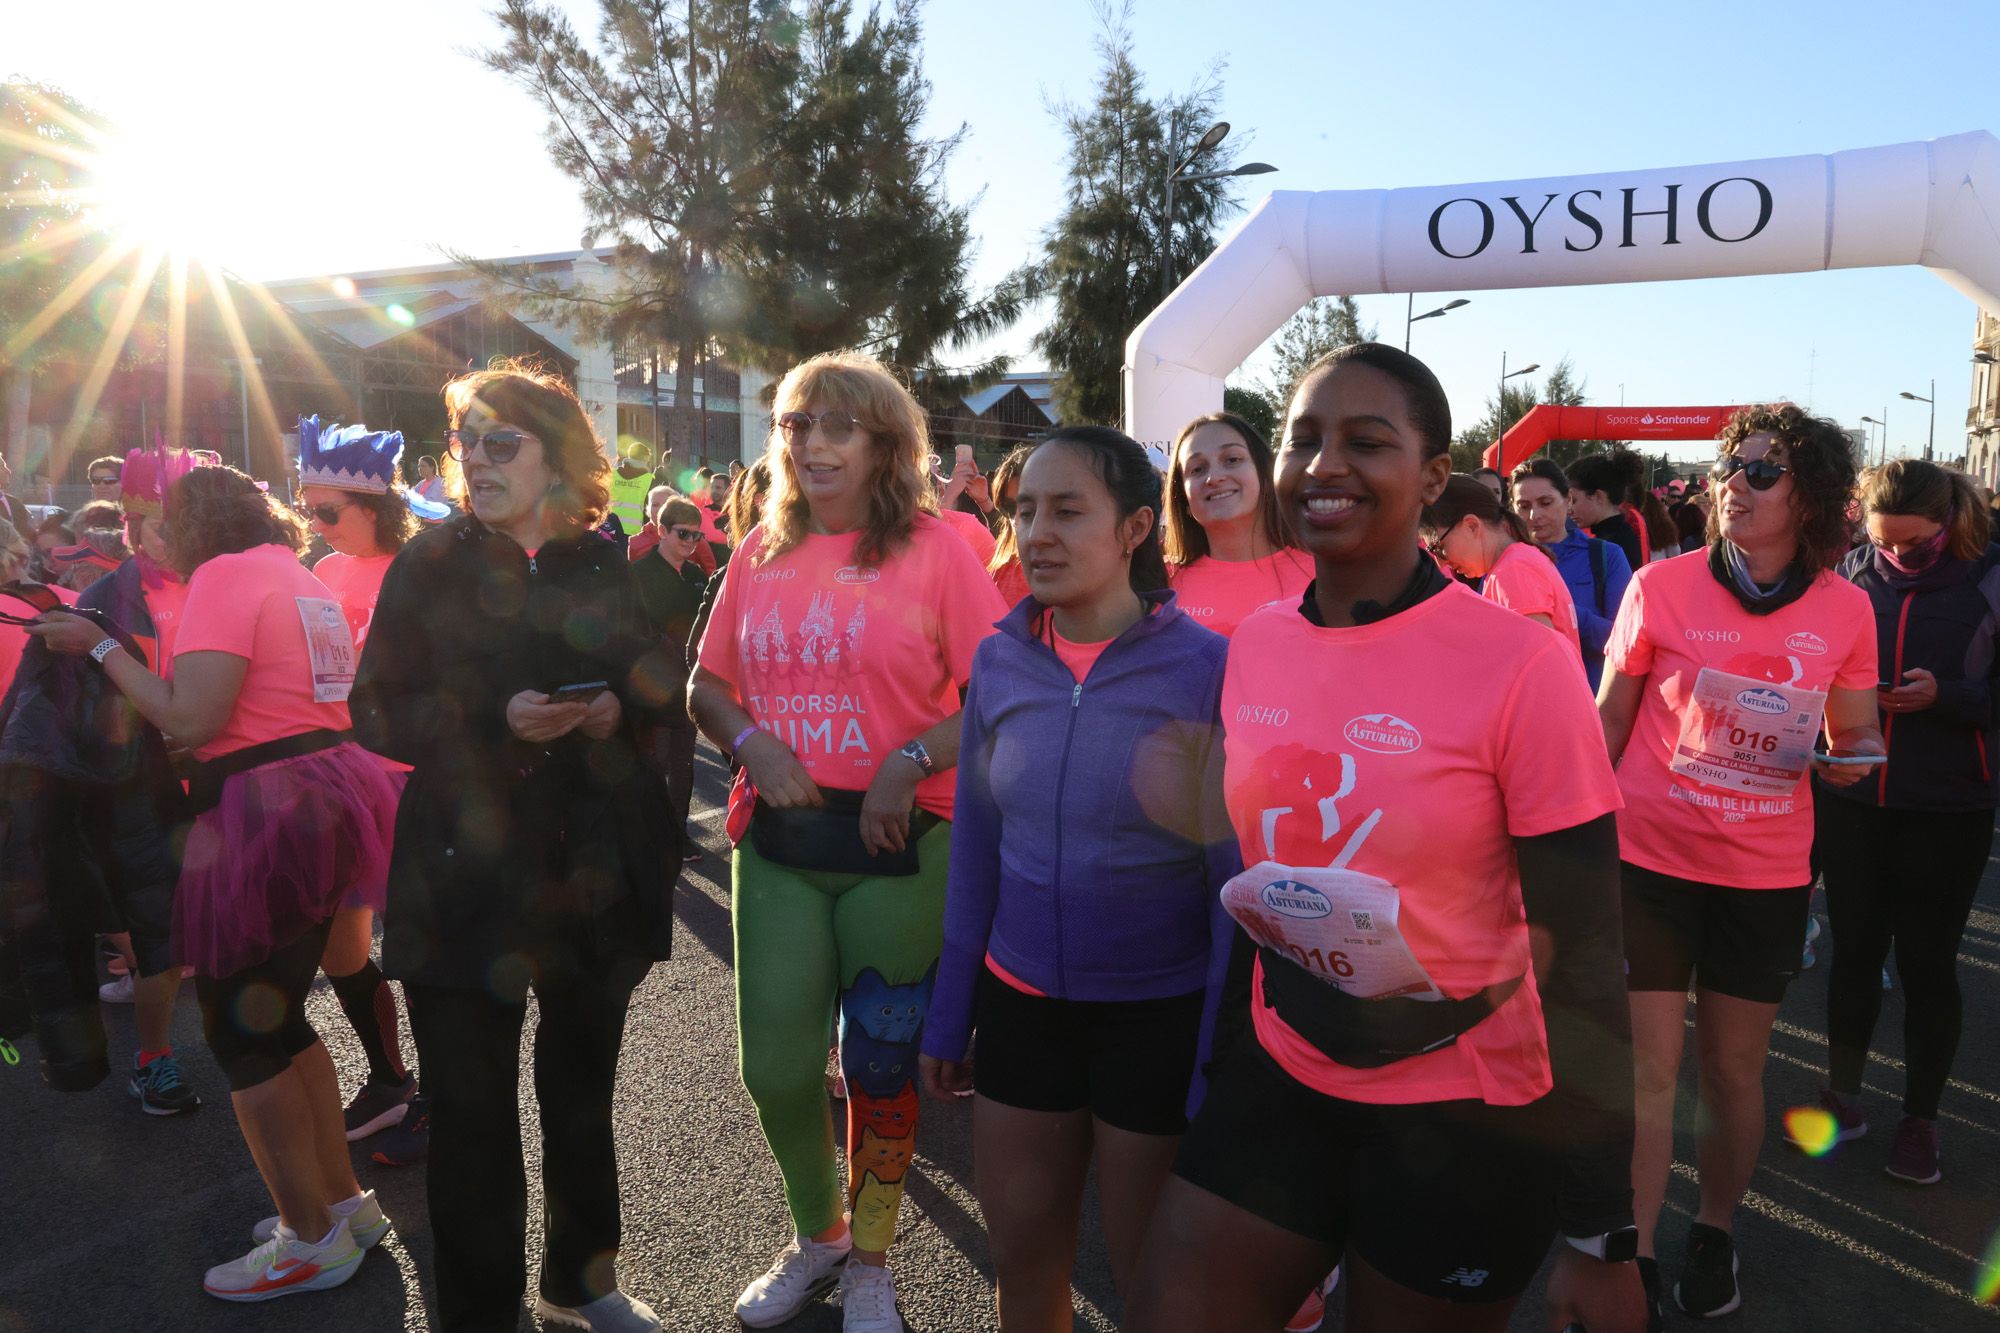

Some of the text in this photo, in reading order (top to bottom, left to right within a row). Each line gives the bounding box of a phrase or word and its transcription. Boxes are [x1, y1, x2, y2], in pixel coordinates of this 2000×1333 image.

[1428, 177, 1773, 259] OYSHO
[1606, 414, 1711, 426] Sports Santander
[754, 568, 796, 584] OYSHO
[1684, 628, 1741, 643] OYSHO
[776, 694, 866, 714] DORSAL
[1741, 694, 1785, 712] ASTURIANA
[1236, 704, 1289, 727] OYSHO
[1348, 722, 1415, 748] ASTURIANA
[1729, 728, 1778, 753] 016
[1733, 751, 1757, 763] 9051
[1686, 762, 1727, 780] OYSHO
[1722, 797, 1737, 810] DE
[1742, 799, 1755, 813] LA
[1723, 811, 1746, 823] 2025
[1267, 891, 1328, 913] ASTURIANA
